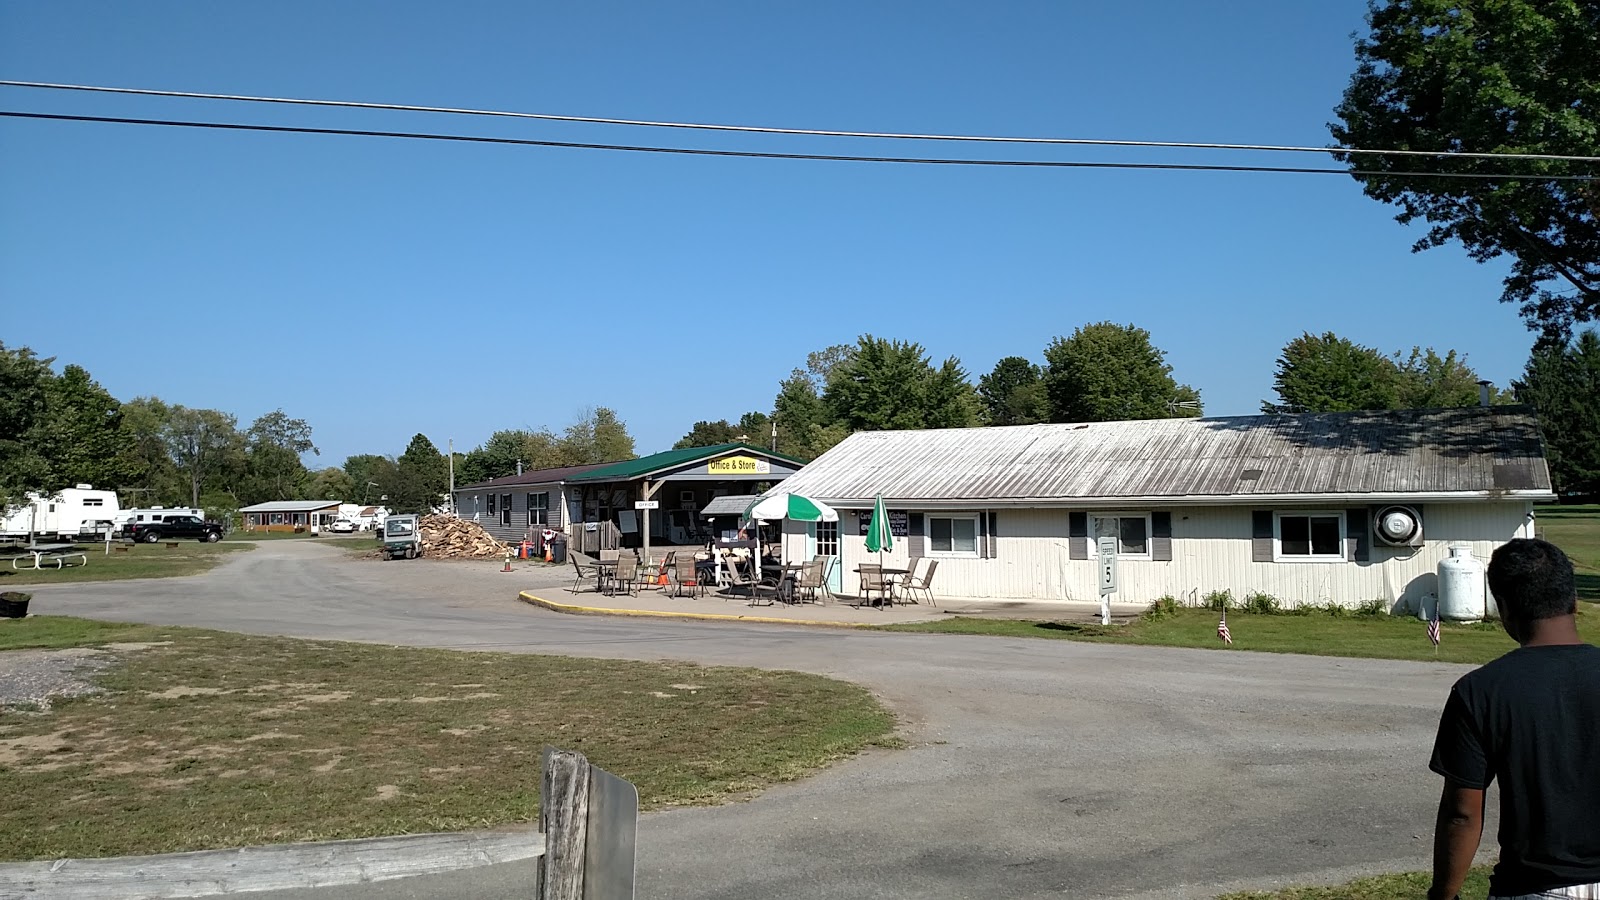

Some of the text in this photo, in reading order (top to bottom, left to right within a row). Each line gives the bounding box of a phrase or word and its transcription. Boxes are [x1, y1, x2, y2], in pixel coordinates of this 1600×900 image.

[710, 460, 730, 470] Office
[731, 460, 737, 470] &
[738, 460, 756, 470] Store
[1102, 547, 1113, 555] SPEED
[1103, 557, 1113, 565] LIMIT
[1106, 566, 1111, 584] 5
